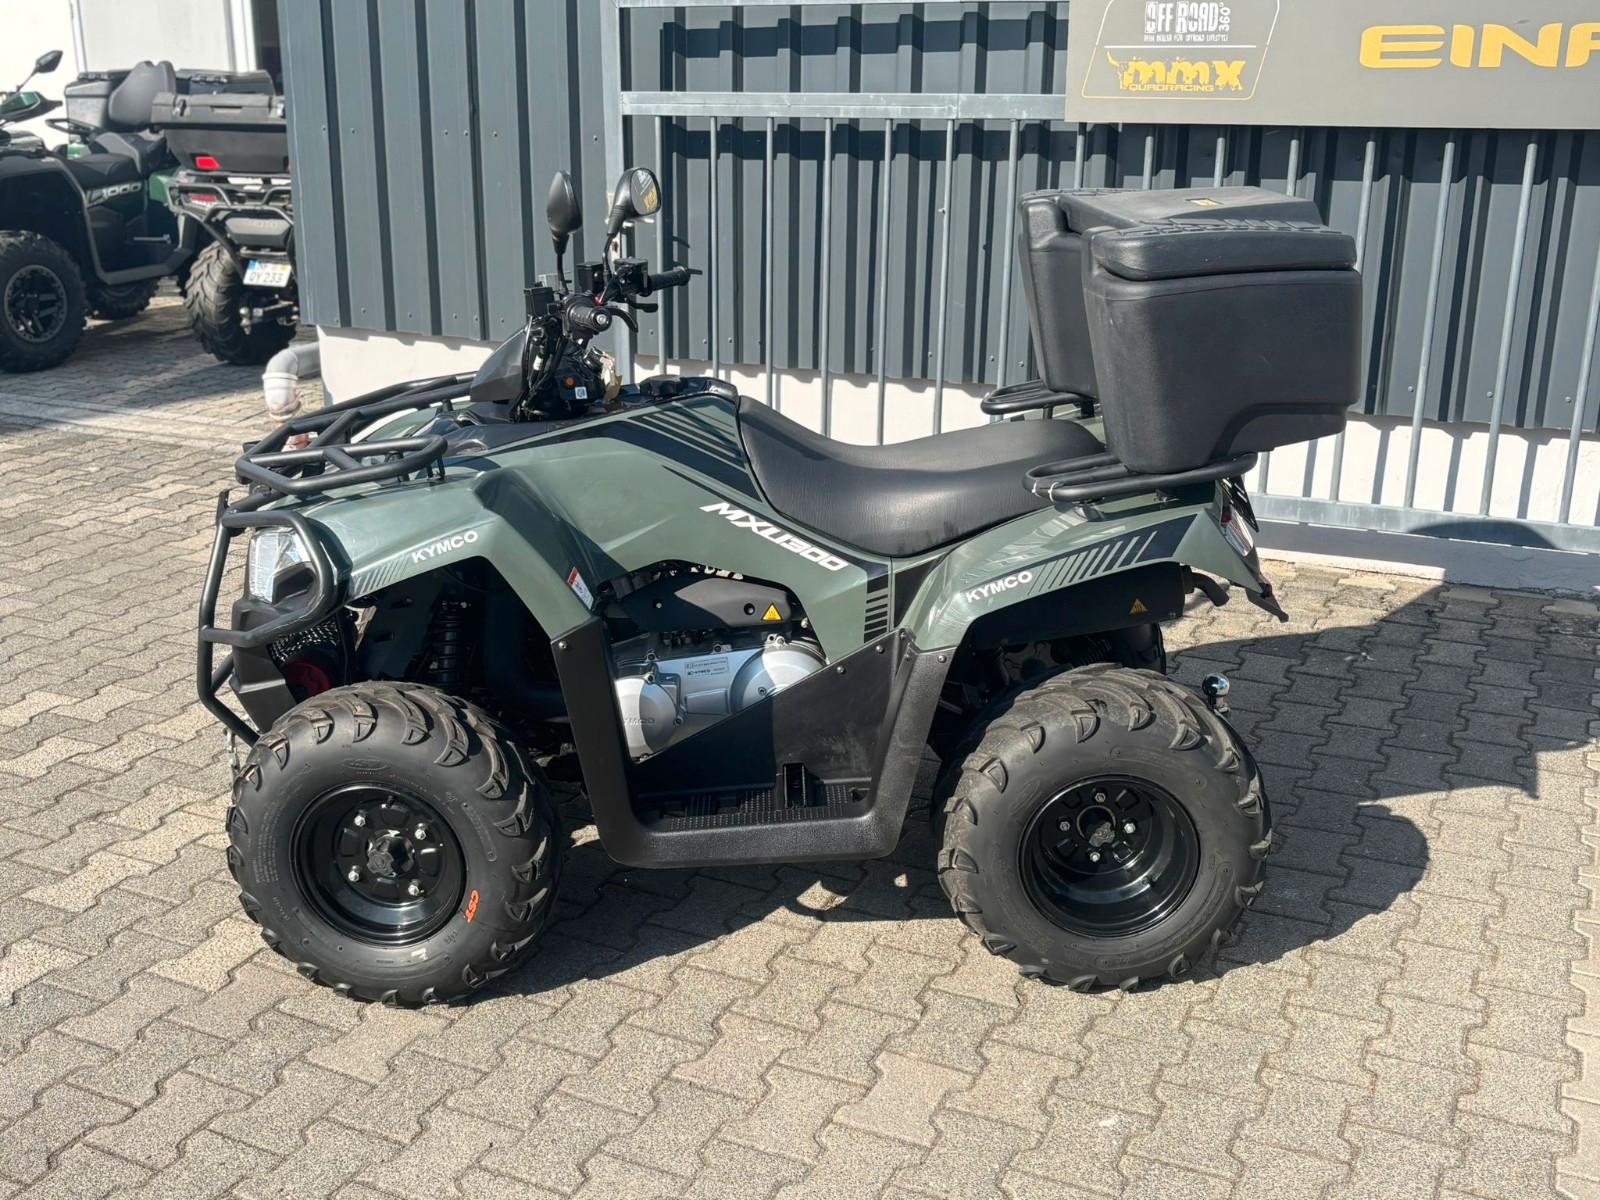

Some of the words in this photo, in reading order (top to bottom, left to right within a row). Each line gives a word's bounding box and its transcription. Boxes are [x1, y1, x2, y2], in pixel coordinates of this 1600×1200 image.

[1145, 1, 1174, 33] OFF
[1175, 1, 1219, 33] ROAD
[1129, 84, 1215, 92] QUADRACING
[411, 530, 478, 563] KYMCO
[700, 502, 849, 571] MXU300
[966, 571, 1033, 603] KYMCO
